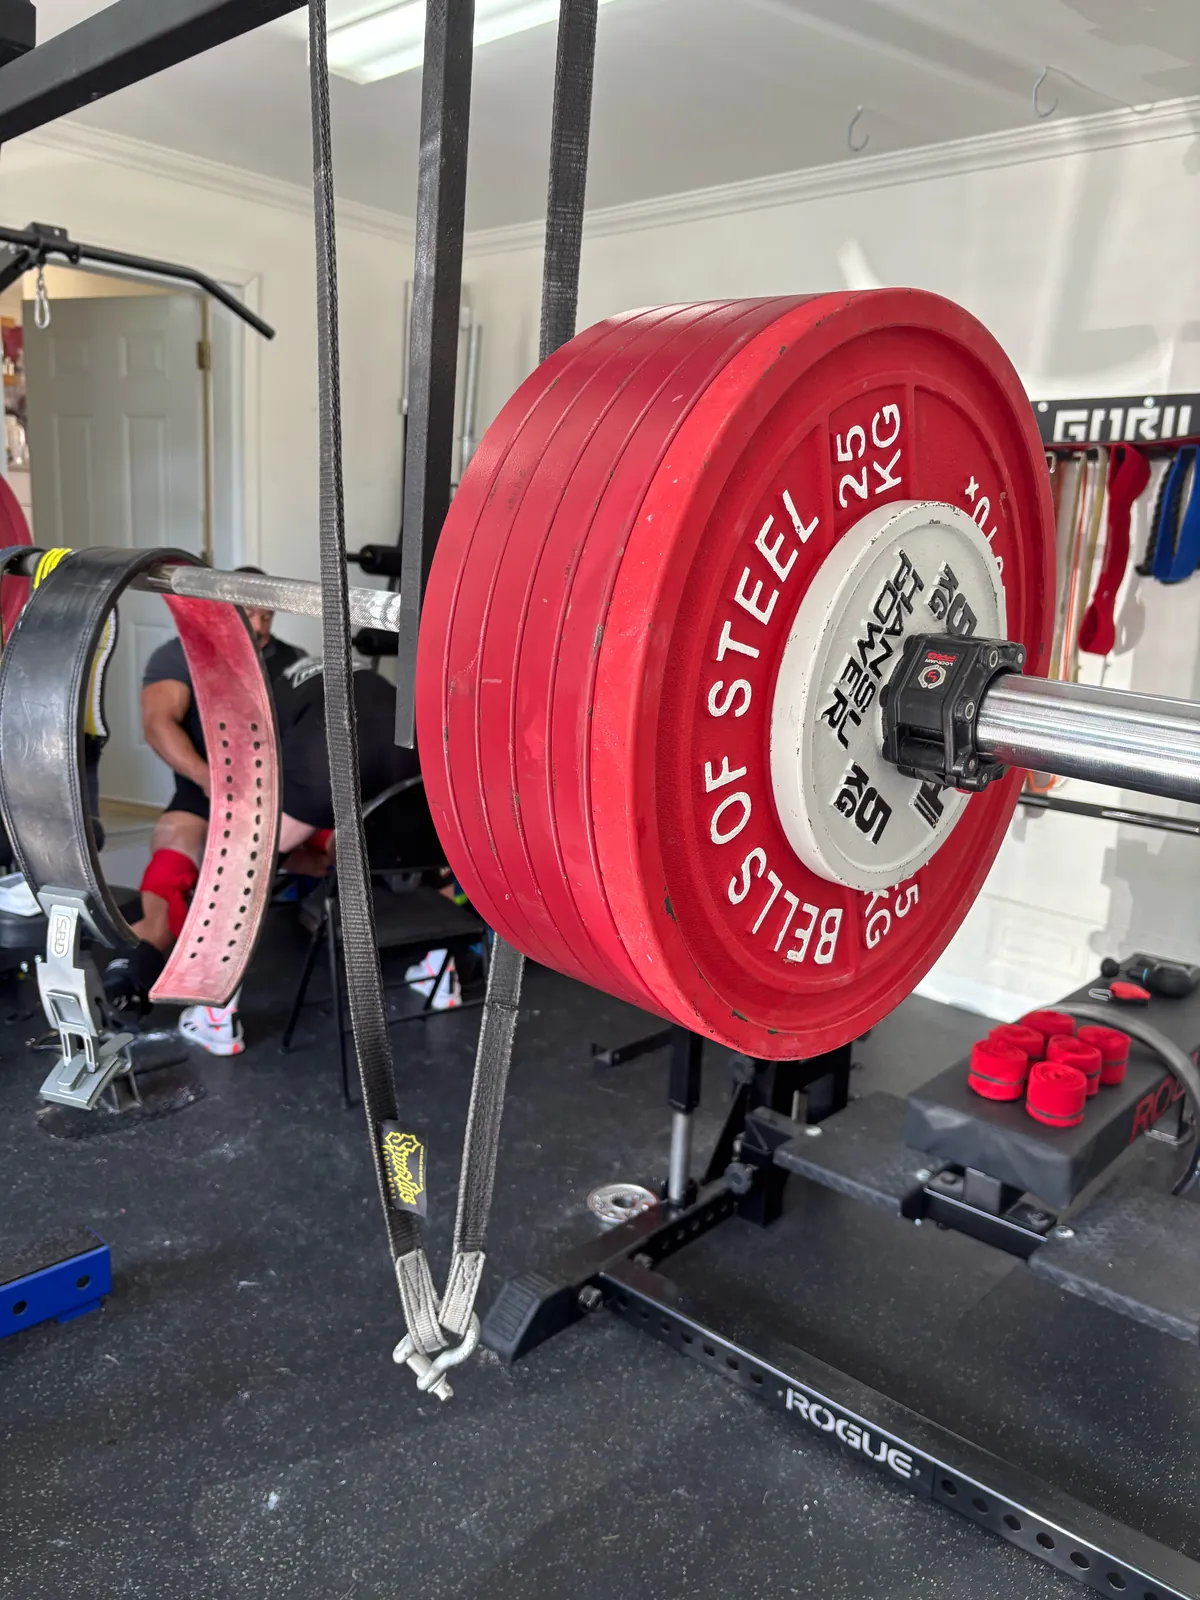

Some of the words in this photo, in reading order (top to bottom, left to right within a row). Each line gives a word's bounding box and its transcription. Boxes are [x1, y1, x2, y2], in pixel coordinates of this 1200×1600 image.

[837, 424, 868, 508] 25
[871, 403, 902, 494] KG
[707, 489, 819, 718] STEEL
[927, 562, 960, 621] KG
[821, 549, 912, 729] POWER
[705, 756, 752, 845] OF
[833, 761, 869, 819] KG
[855, 786, 893, 845] 5
[55, 917, 68, 955] SBD
[728, 847, 844, 965] BELLS
[894, 882, 919, 918] 5
[785, 1388, 914, 1479] ROGUE
